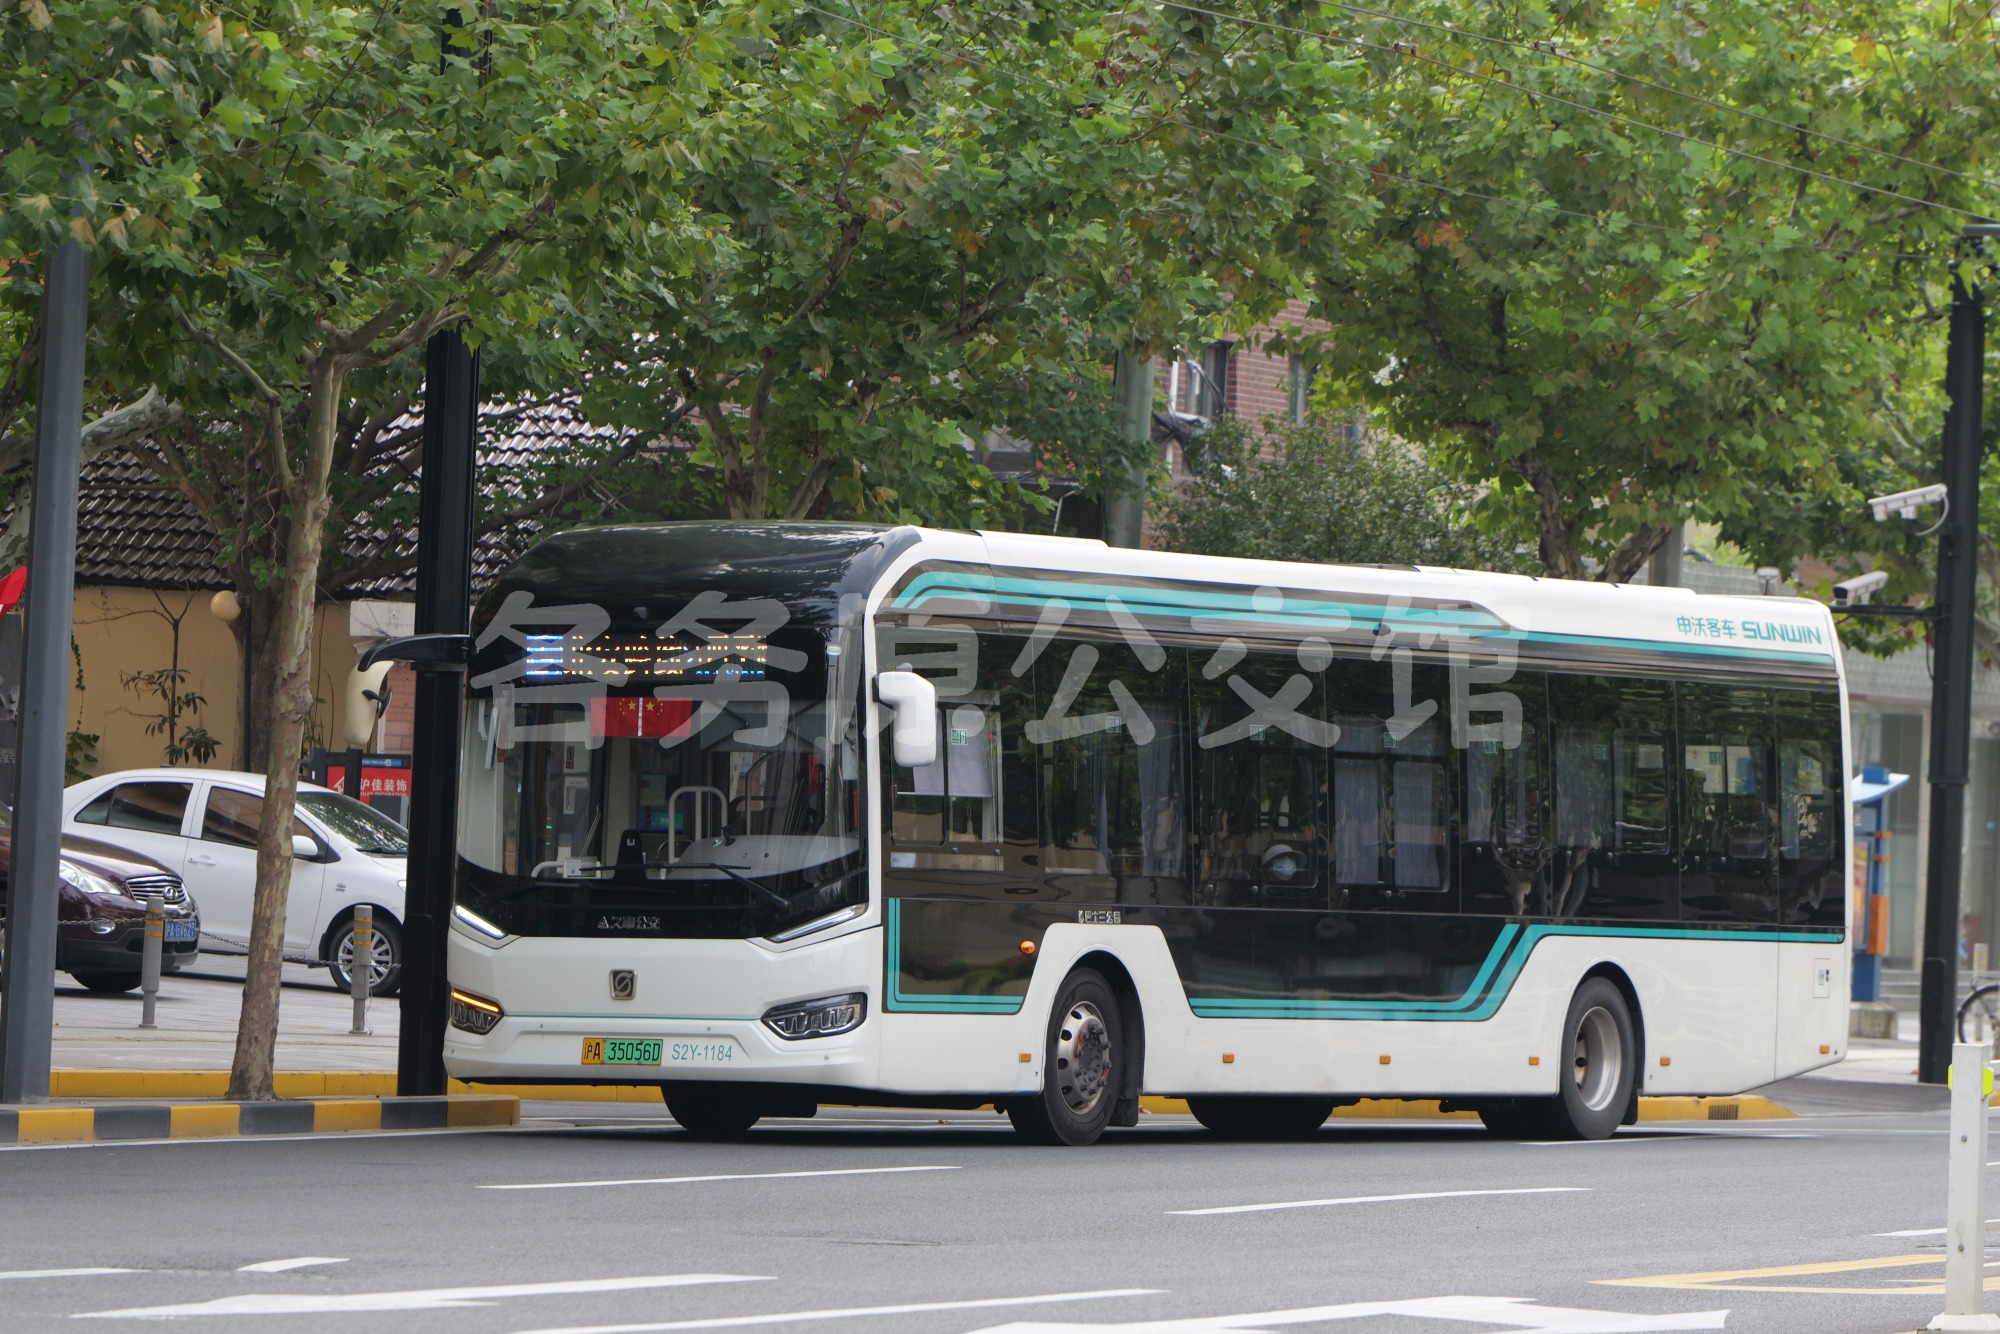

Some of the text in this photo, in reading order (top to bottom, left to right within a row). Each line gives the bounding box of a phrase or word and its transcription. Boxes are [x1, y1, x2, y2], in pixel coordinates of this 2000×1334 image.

[1676, 615, 1822, 645] 申沃客车 SUNWIN
[671, 1043, 733, 1061] S2Y-1184
